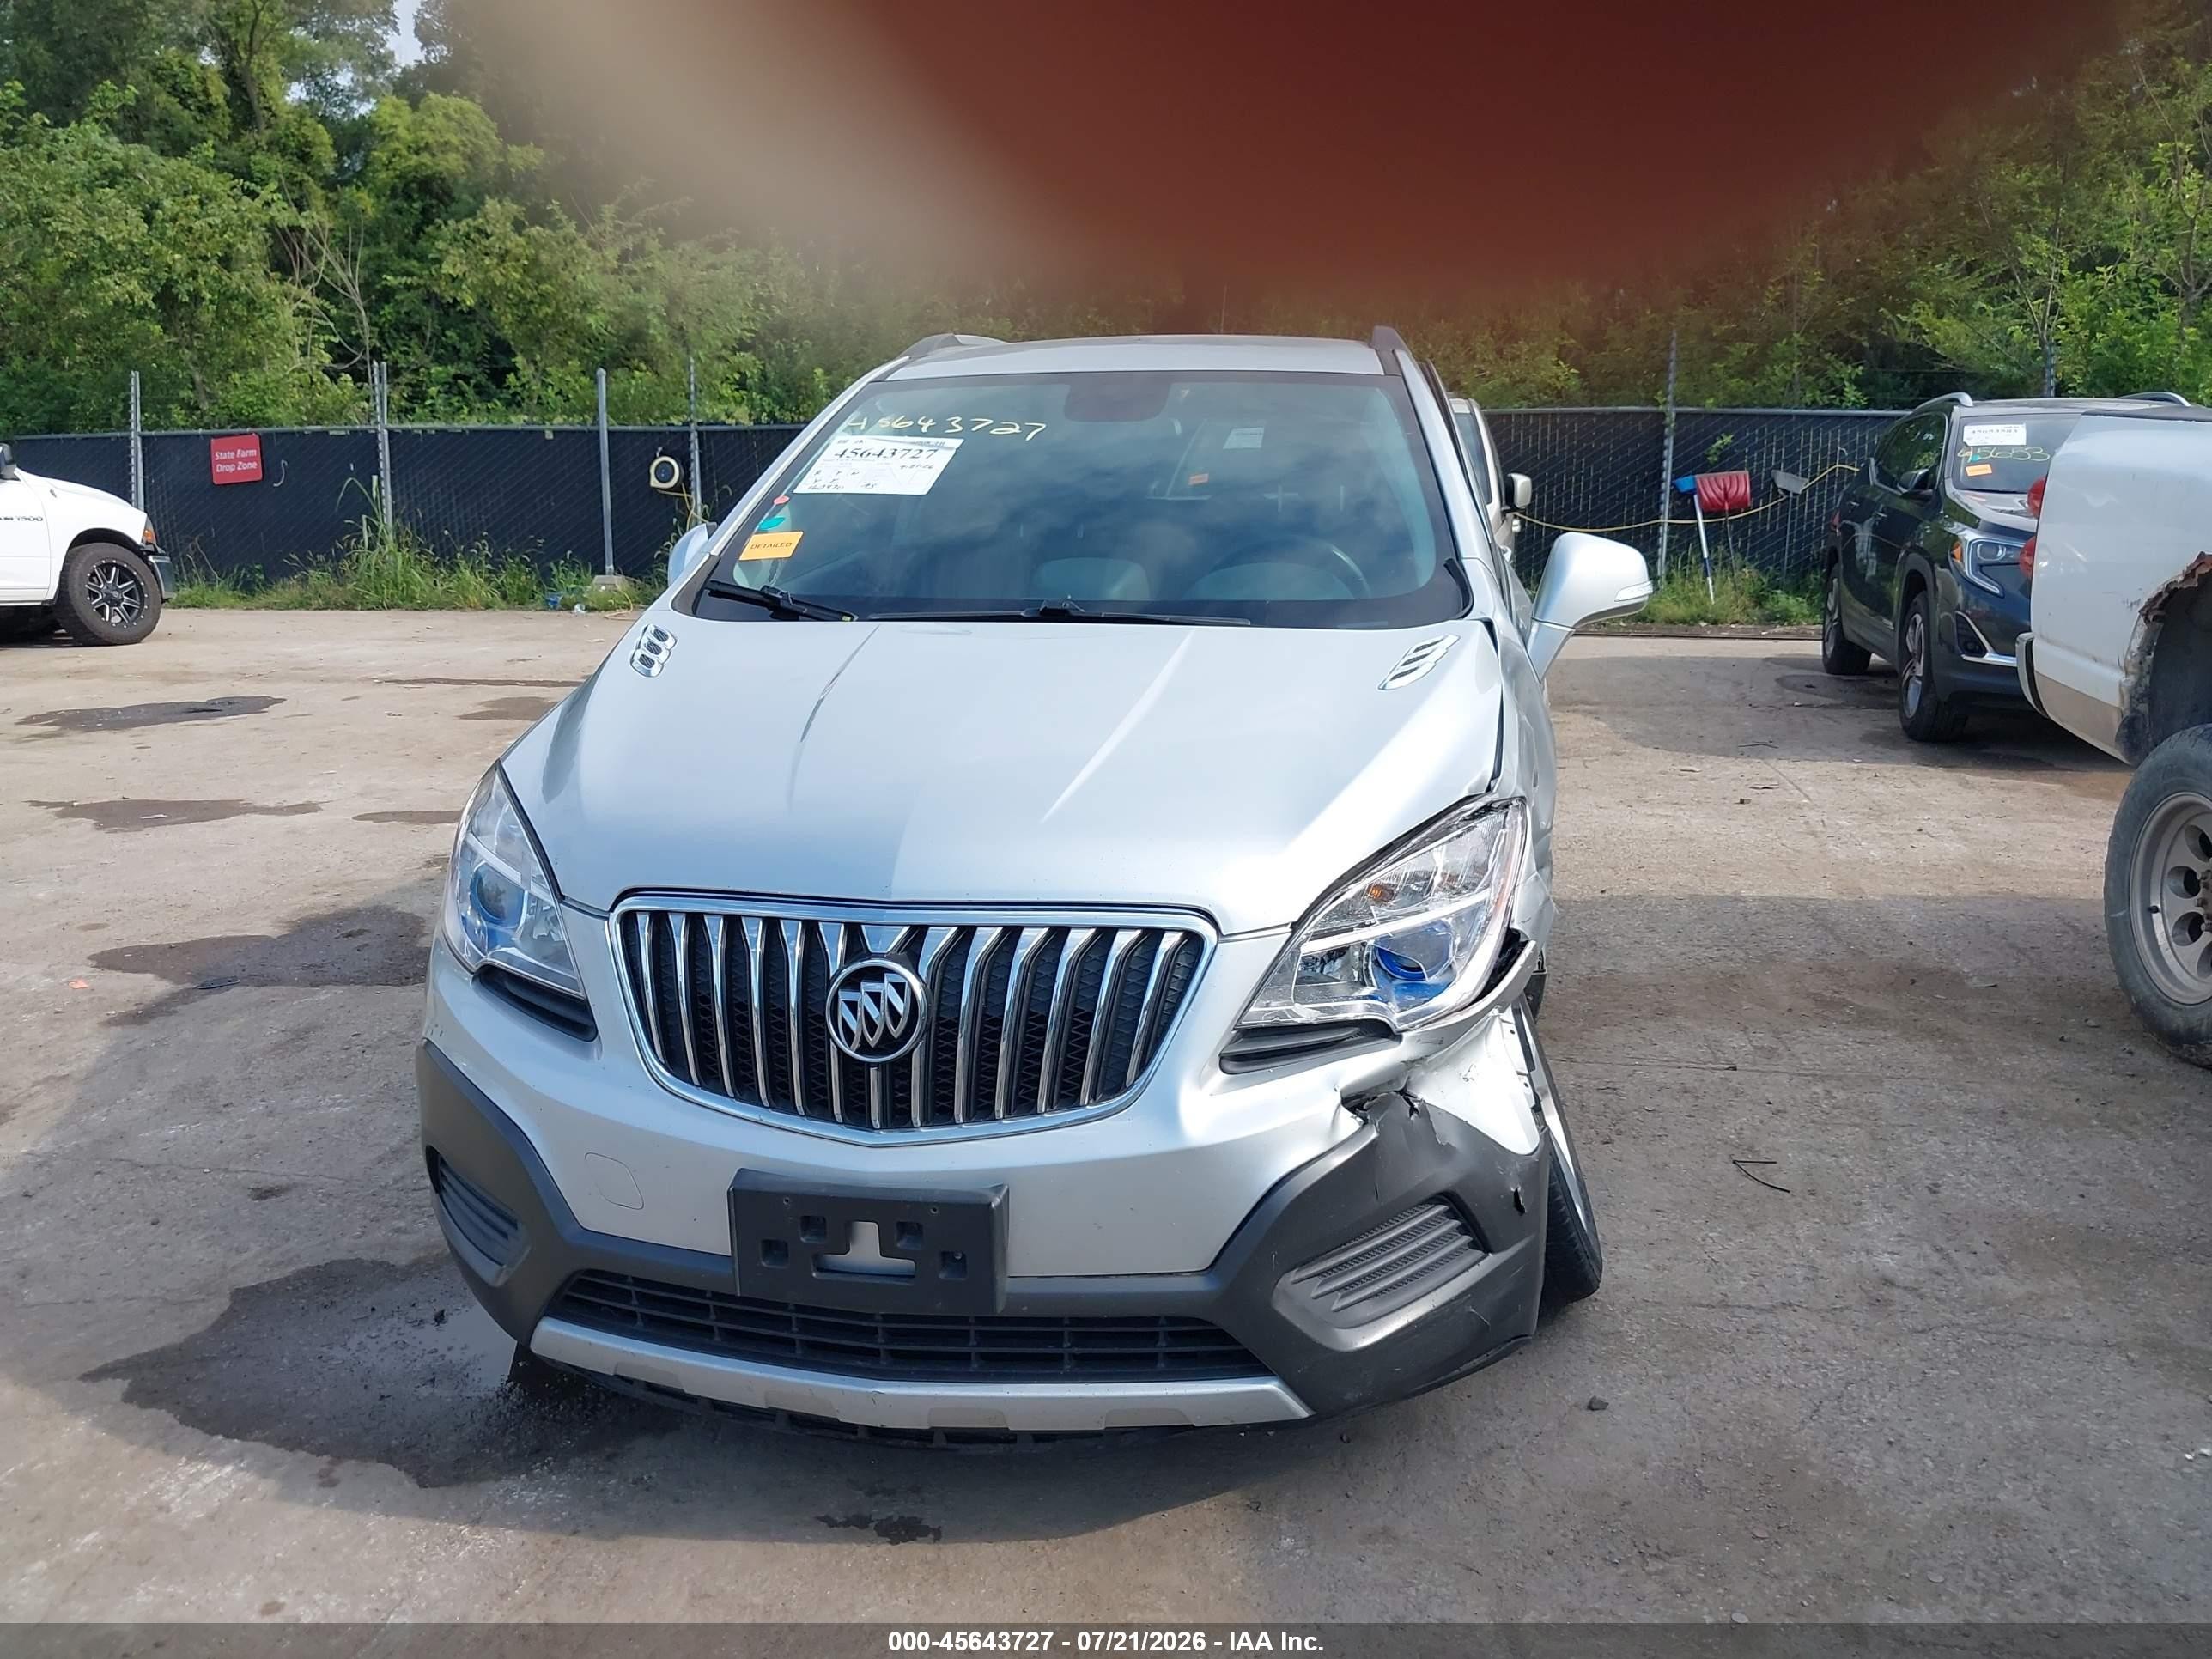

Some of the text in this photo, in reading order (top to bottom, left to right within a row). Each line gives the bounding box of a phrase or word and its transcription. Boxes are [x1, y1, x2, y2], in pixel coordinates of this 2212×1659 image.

[215, 448, 257, 461] State Farm
[834, 447, 939, 459] 45643727
[216, 461, 258, 473] Drop Zone
